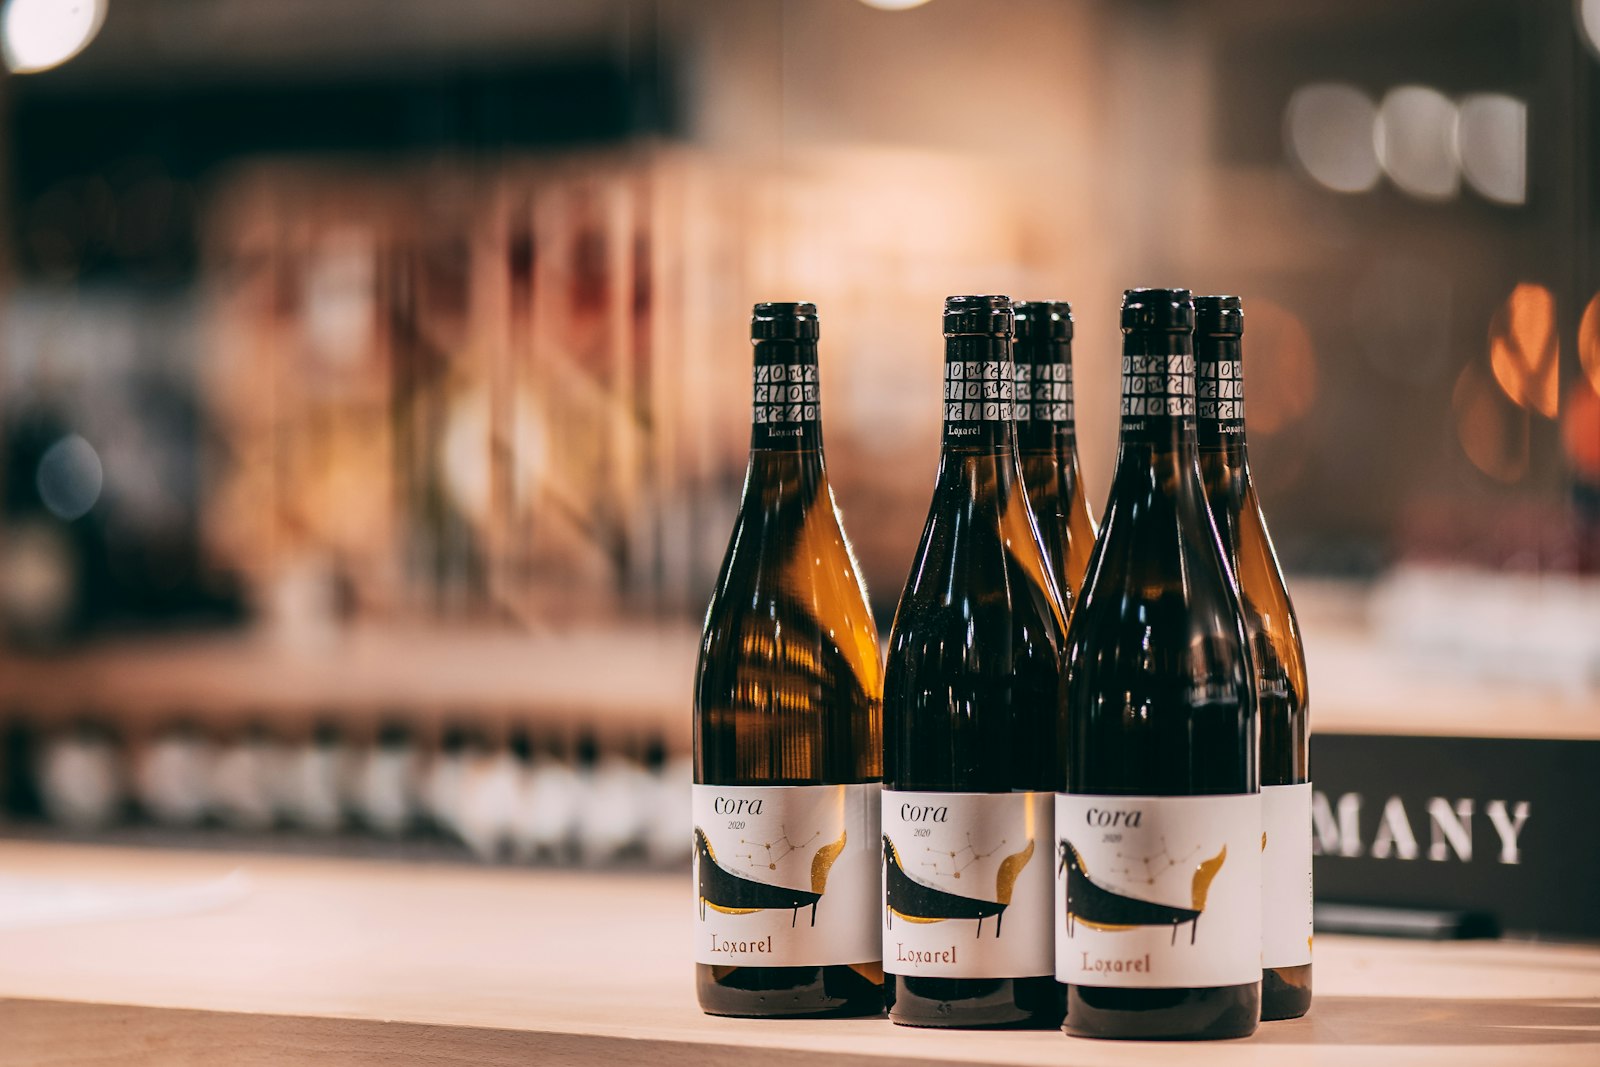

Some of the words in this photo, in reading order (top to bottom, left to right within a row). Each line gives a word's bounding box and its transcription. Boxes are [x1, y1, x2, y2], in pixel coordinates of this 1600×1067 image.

[948, 425, 981, 437] Loxarel
[714, 796, 763, 815] cora
[901, 803, 948, 823] cora
[727, 820, 746, 830] 2020
[1086, 807, 1143, 828] cora
[913, 828, 931, 838] 2020
[710, 934, 772, 957] Loxarel
[896, 942, 957, 967] Loxarel
[1081, 952, 1151, 977] Loxarel
